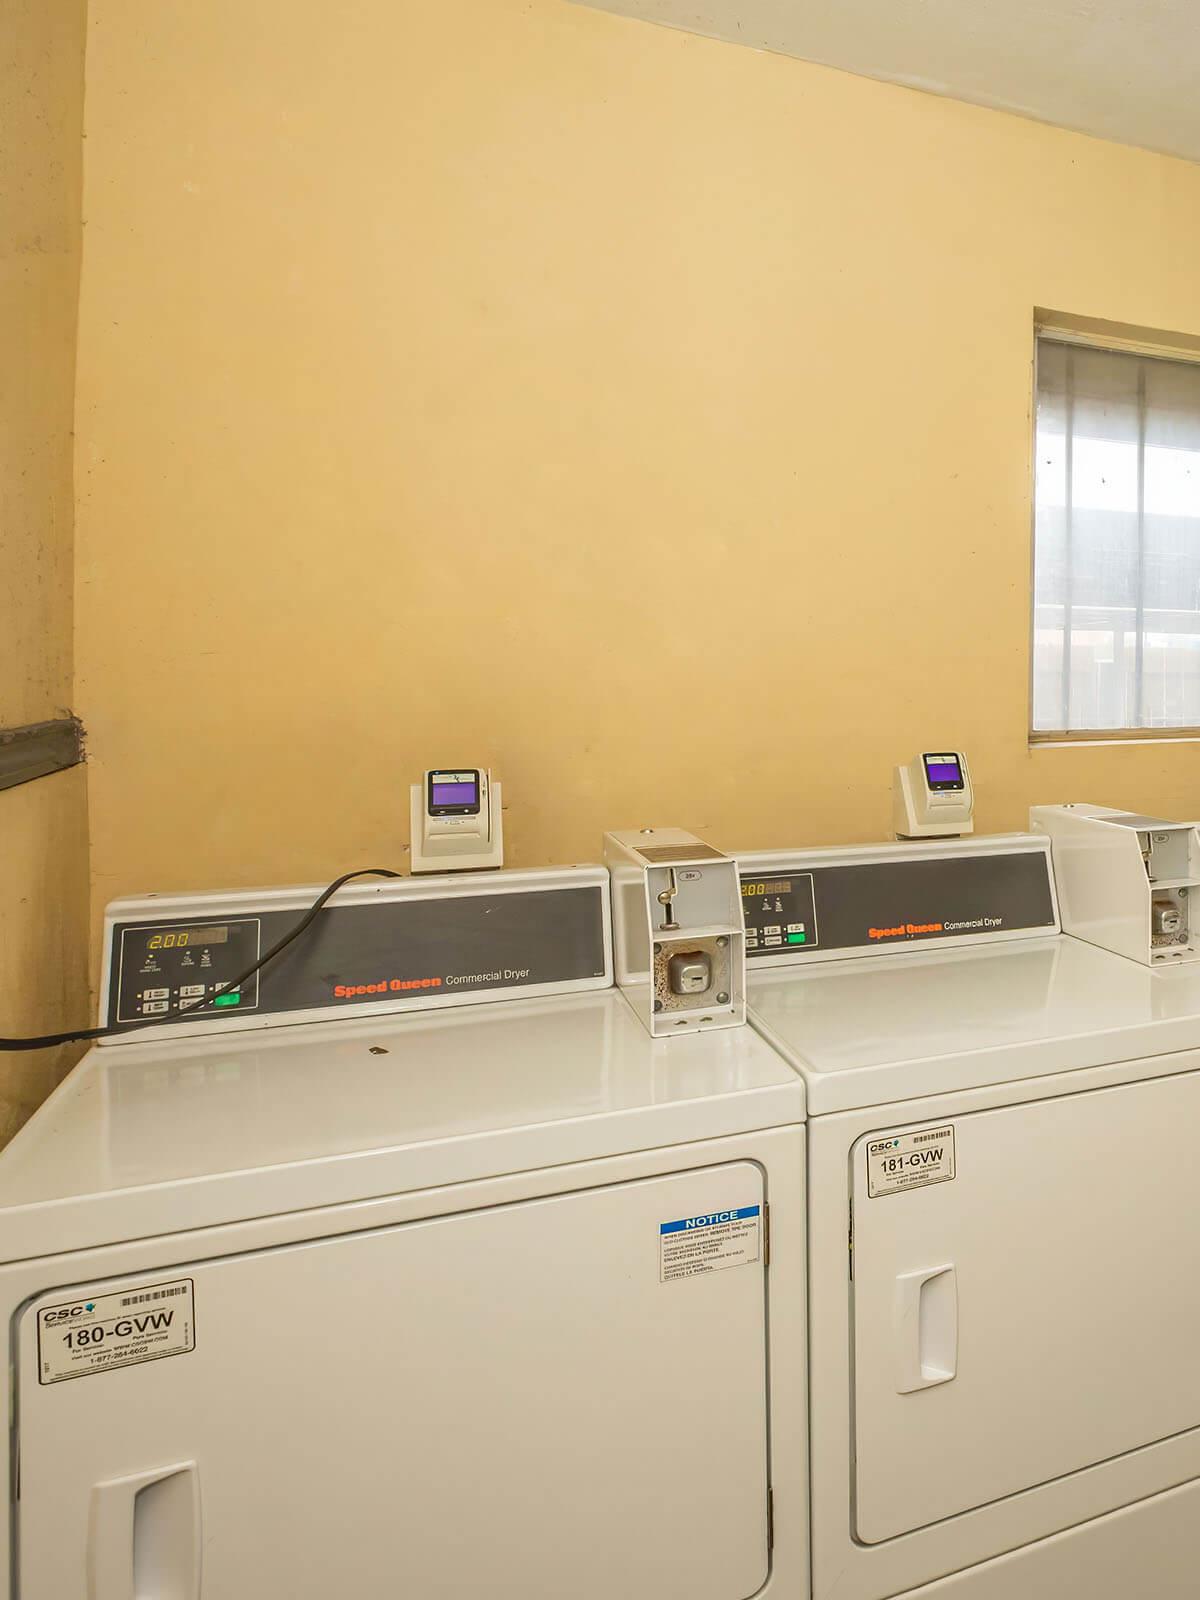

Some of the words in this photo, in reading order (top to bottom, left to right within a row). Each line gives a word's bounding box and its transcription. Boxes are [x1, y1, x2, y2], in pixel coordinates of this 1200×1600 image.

[868, 925, 905, 938] Speed
[907, 923, 943, 934] Queen
[944, 918, 983, 930] Commercial
[985, 918, 1002, 928] Dryer
[333, 980, 387, 998] Speed
[390, 977, 442, 992] Queen
[446, 970, 502, 985] Commercial
[505, 968, 530, 981] Dryer
[870, 1142, 892, 1152] CSC
[881, 1148, 943, 1172] 181-GVW
[686, 1210, 738, 1228] NOTICE
[44, 1306, 84, 1322] CSC
[63, 1310, 174, 1348] 180-GVW
